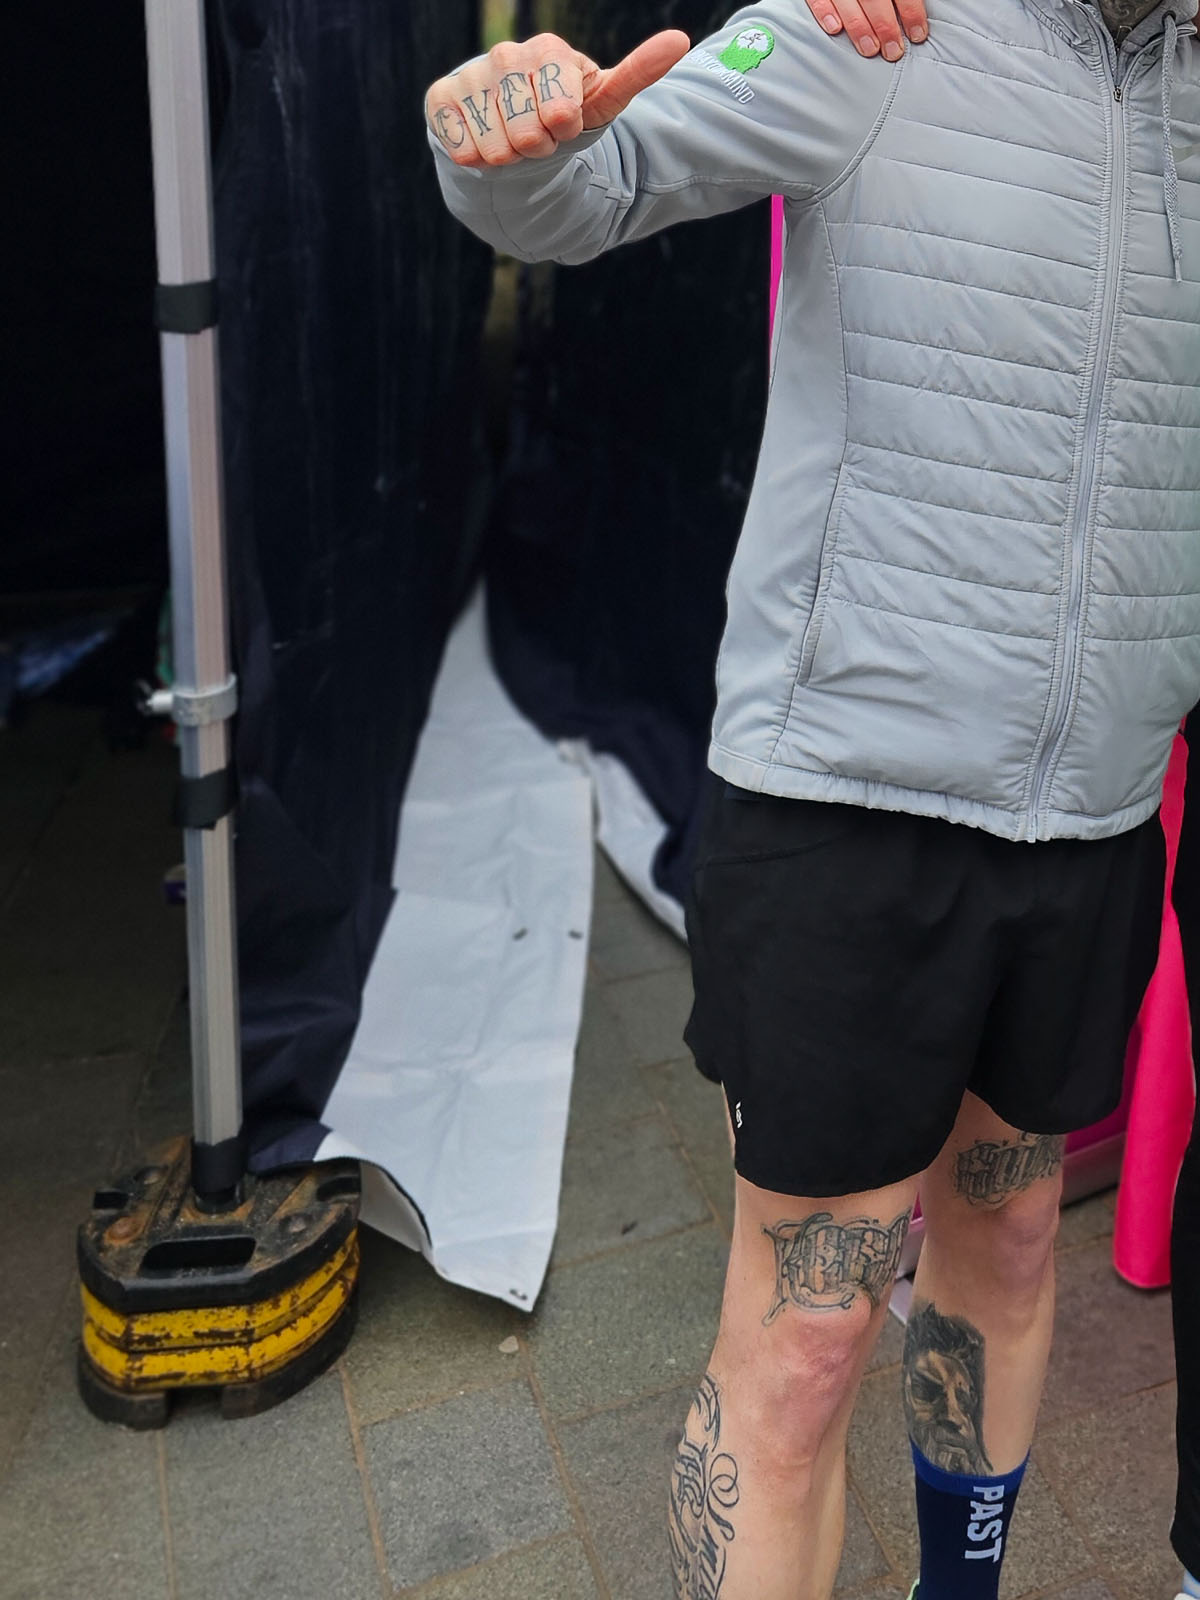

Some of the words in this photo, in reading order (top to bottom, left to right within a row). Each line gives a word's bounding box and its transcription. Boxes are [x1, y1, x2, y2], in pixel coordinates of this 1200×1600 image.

[434, 63, 573, 149] OVER
[721, 69, 755, 104] MIND
[964, 1484, 1005, 1563] PAST
